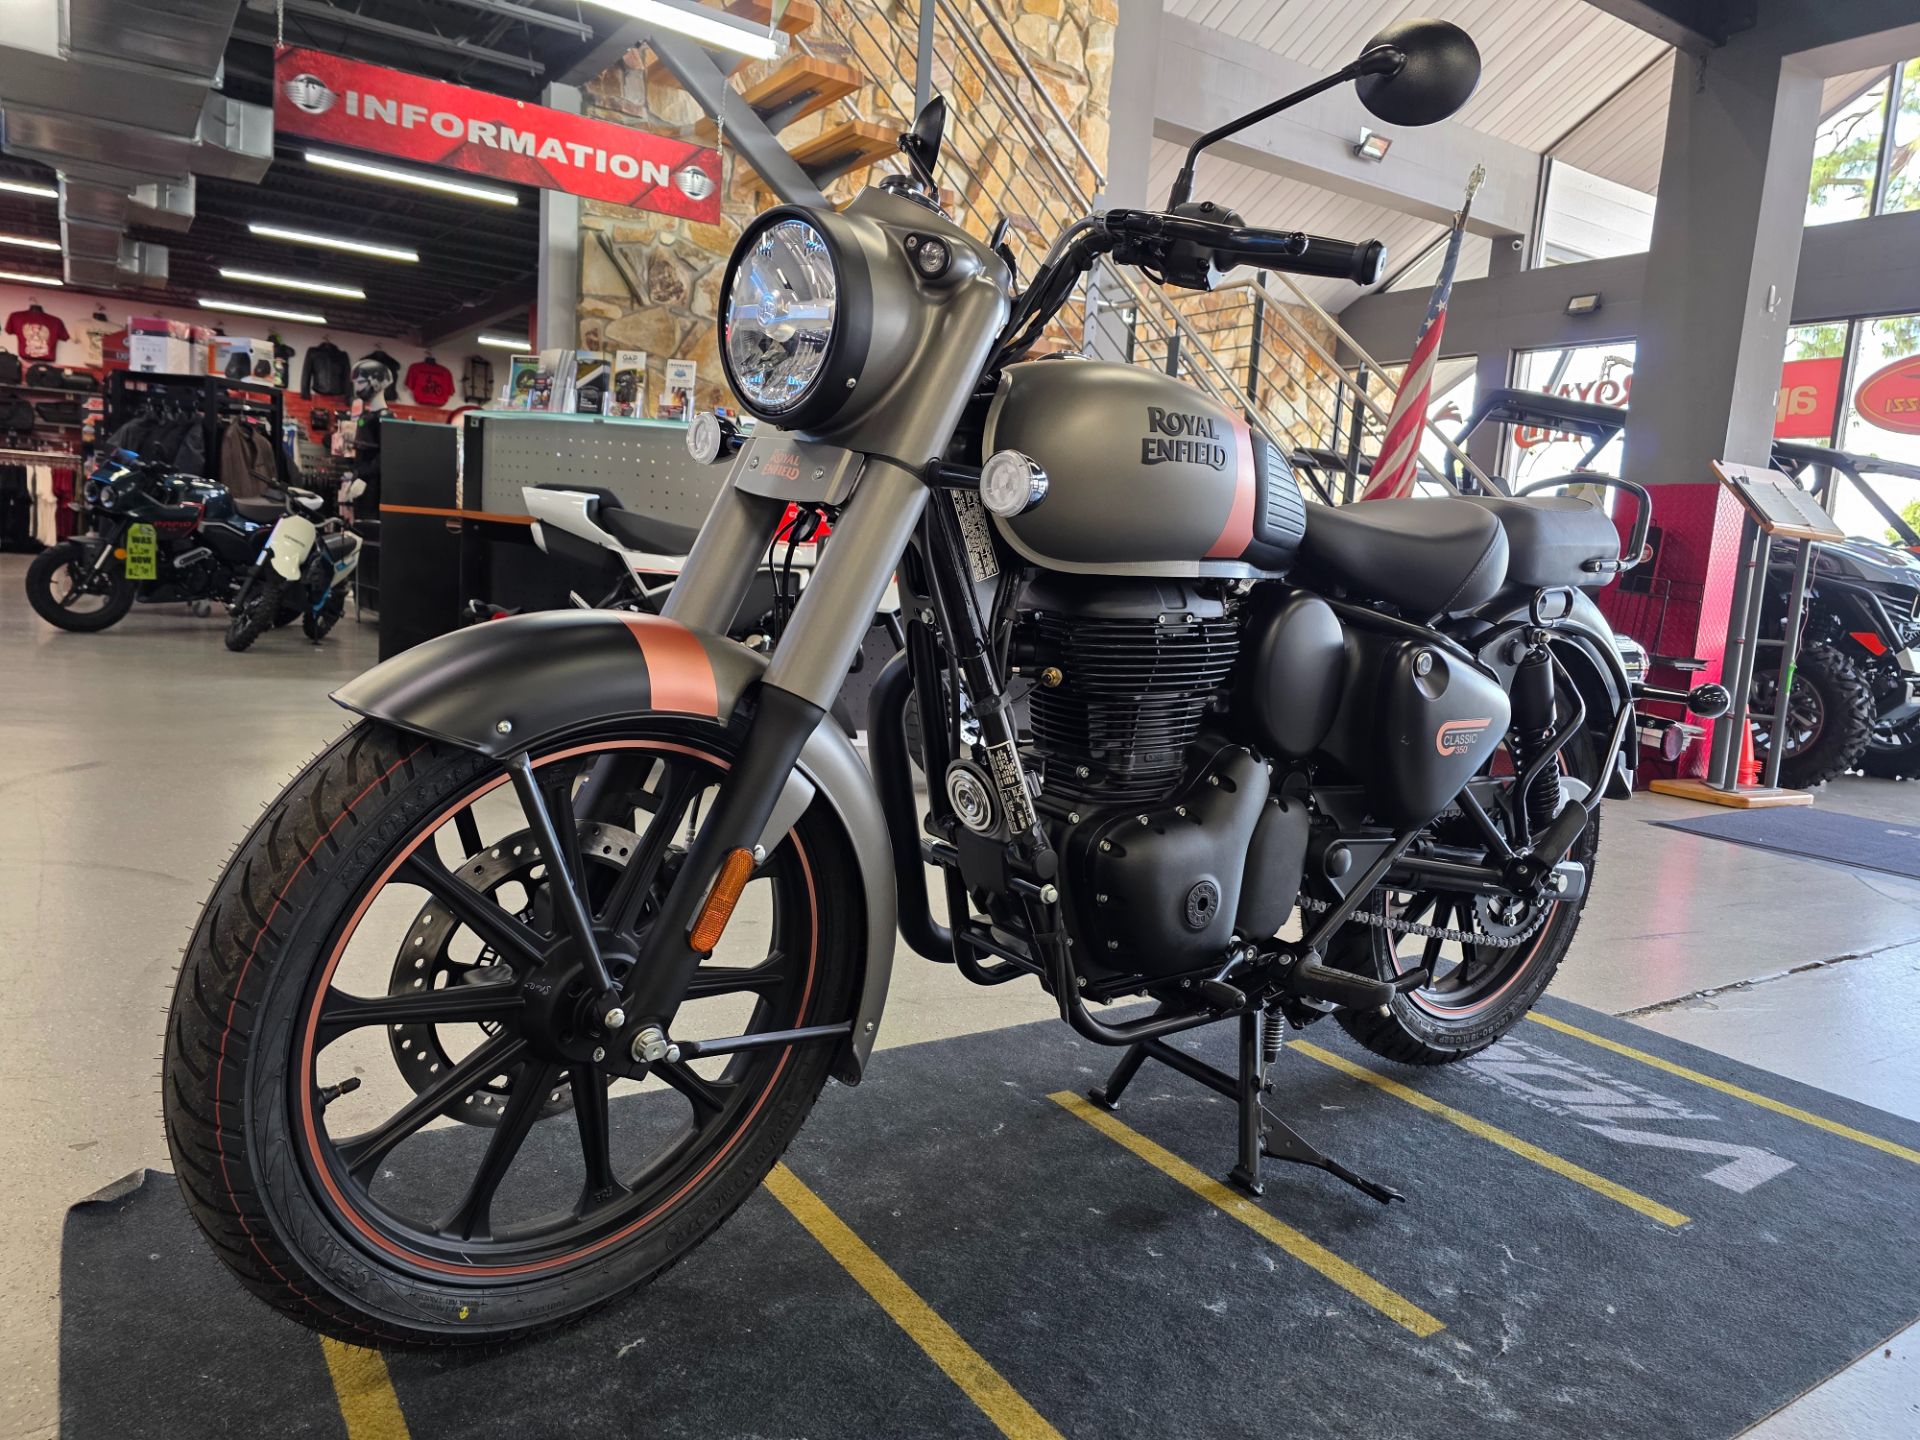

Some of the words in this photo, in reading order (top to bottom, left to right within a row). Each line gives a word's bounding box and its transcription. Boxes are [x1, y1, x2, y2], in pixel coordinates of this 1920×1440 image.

[345, 90, 671, 188] INFORMATION
[1147, 406, 1219, 440] ROYAL
[771, 449, 801, 466] ROYAL
[1141, 438, 1227, 471] ENFIELD
[761, 463, 800, 480] ENFIELD
[131, 536, 152, 545] WAS
[130, 556, 152, 564] NOW
[1443, 733, 1479, 746] CLASSIC
[1454, 745, 1468, 755] 350
